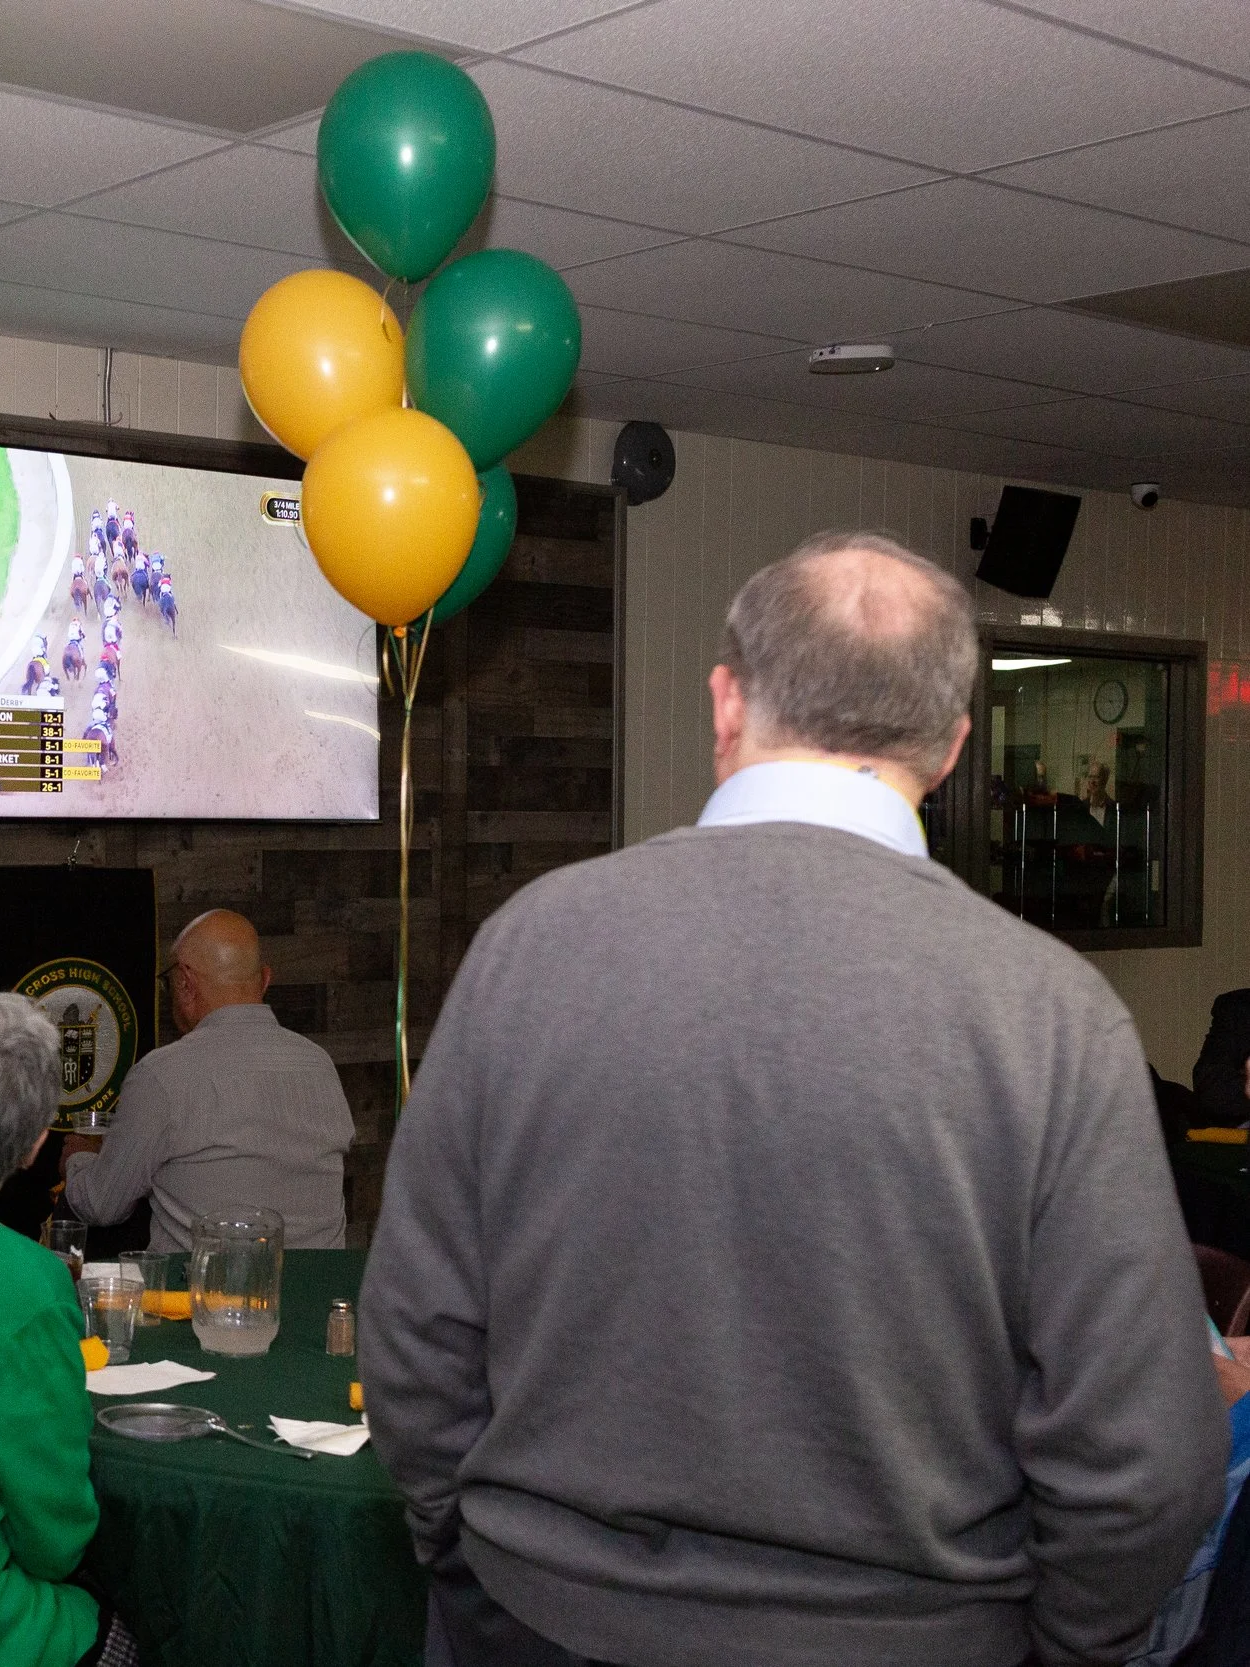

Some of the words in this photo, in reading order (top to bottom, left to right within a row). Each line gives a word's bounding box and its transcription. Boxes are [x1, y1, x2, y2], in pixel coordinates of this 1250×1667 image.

[274, 501, 285, 509] 3/4
[286, 502, 300, 510] MILE
[276, 509, 298, 519] 1:10.90
[43, 713, 62, 723] 12-1
[42, 727, 63, 737] 38-1
[45, 741, 60, 751] 5-1
[45, 755, 60, 765] 8-1
[45, 769, 60, 778] 5-1
[63, 769, 100, 777] CO-FAVORITE
[42, 783, 62, 792] 26-1
[25, 969, 66, 996] CROSS
[69, 968, 102, 984] HIGH
[102, 979, 130, 1032] SCHOOL
[90, 1087, 114, 1112] YORK
